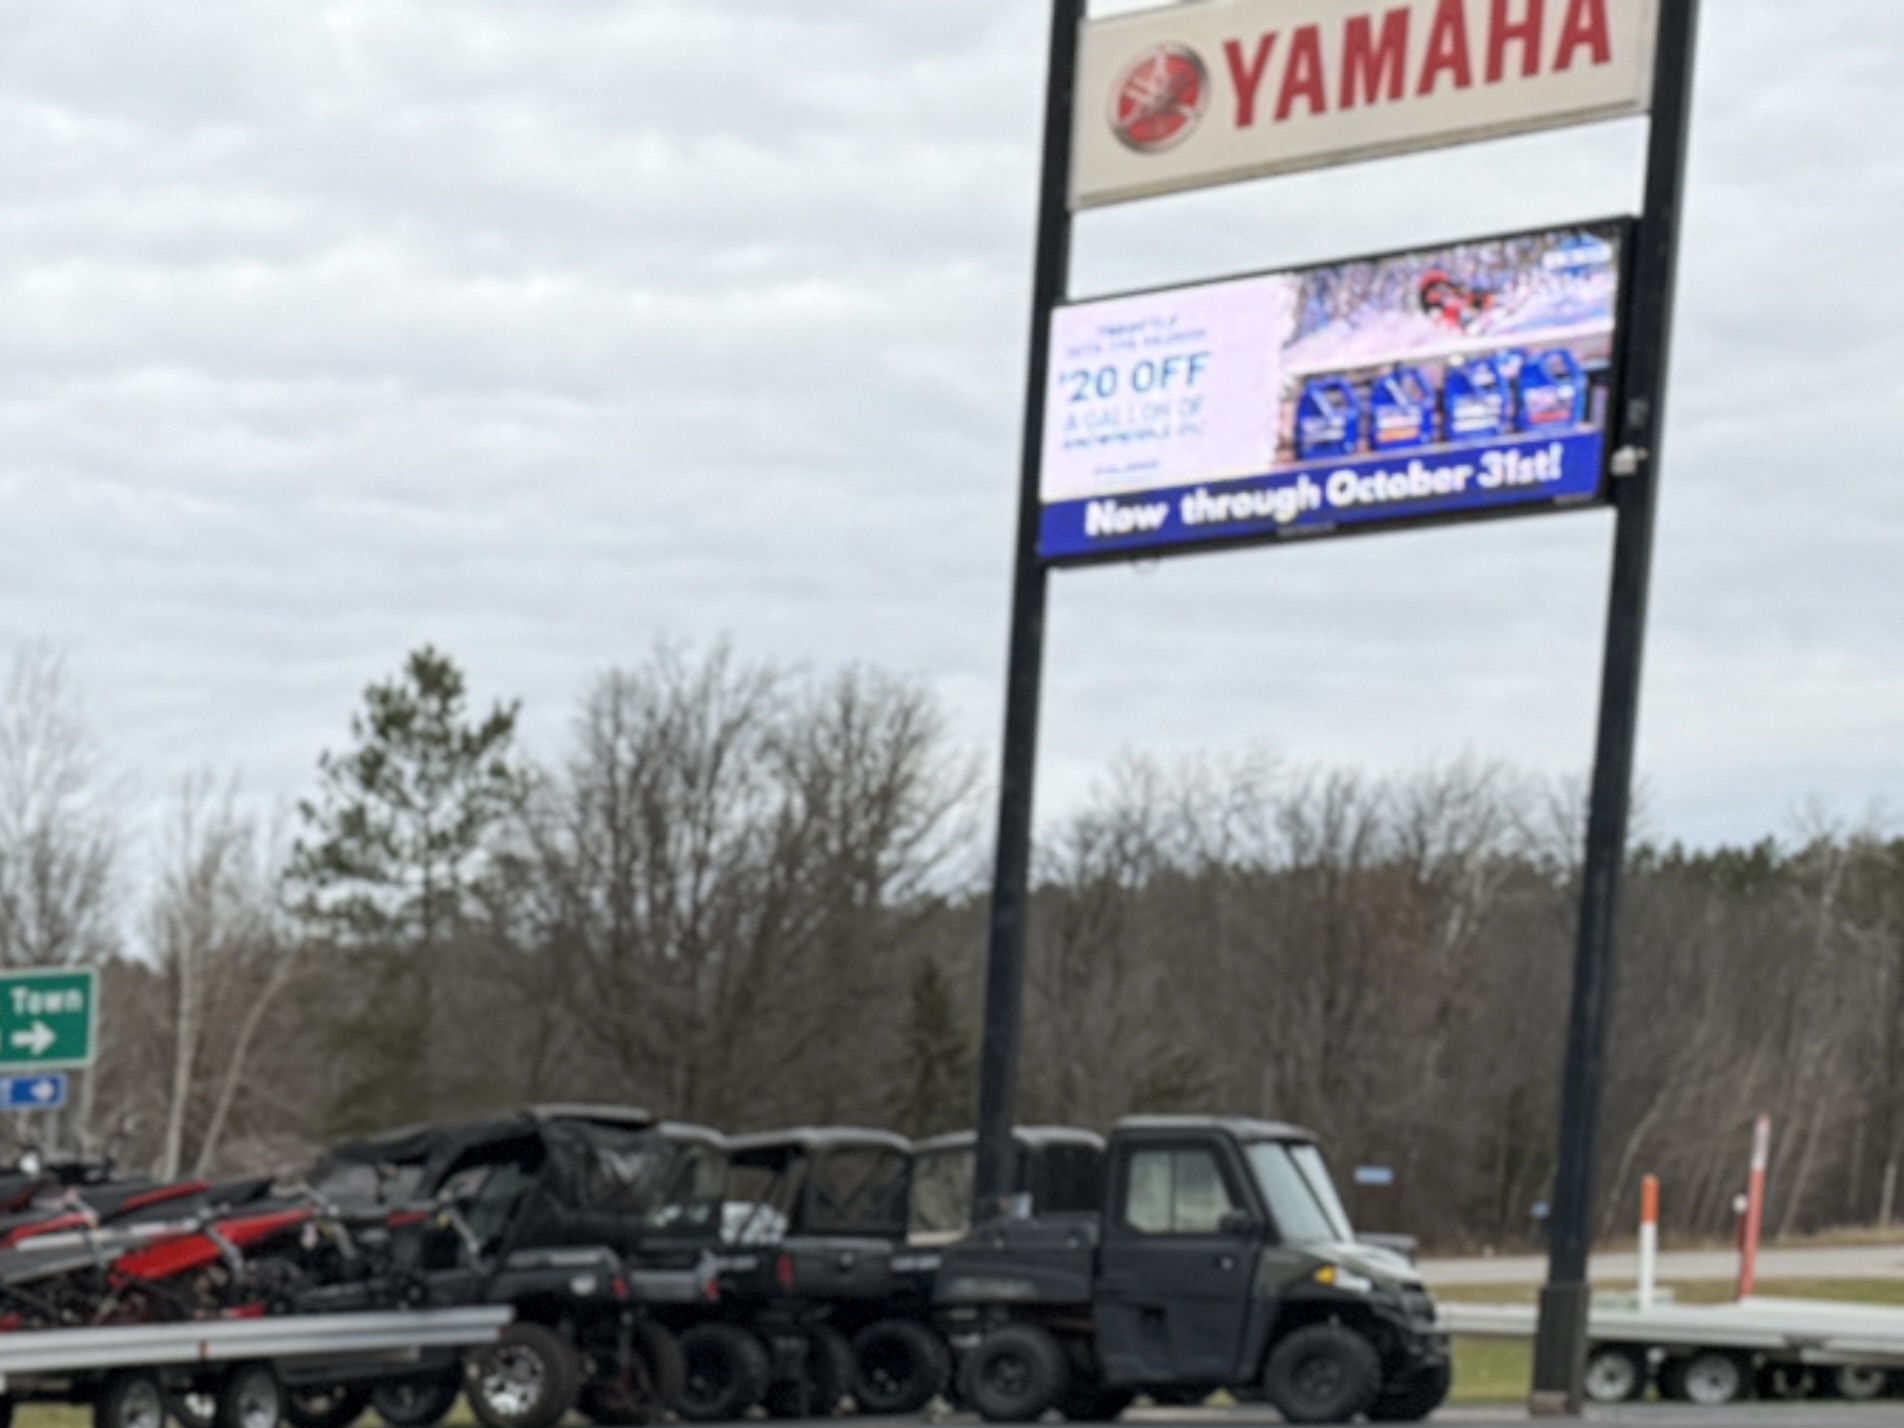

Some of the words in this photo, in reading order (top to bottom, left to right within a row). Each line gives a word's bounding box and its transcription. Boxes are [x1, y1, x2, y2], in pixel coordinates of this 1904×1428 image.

[1222, 0, 1612, 130] YAMAHA
[1131, 350, 1211, 393] OFF
[1084, 500, 1168, 536] Now
[1180, 471, 1322, 523] through
[1324, 460, 1474, 507] October
[1476, 443, 1564, 488] 31st!
[10, 986, 84, 1015] Town
